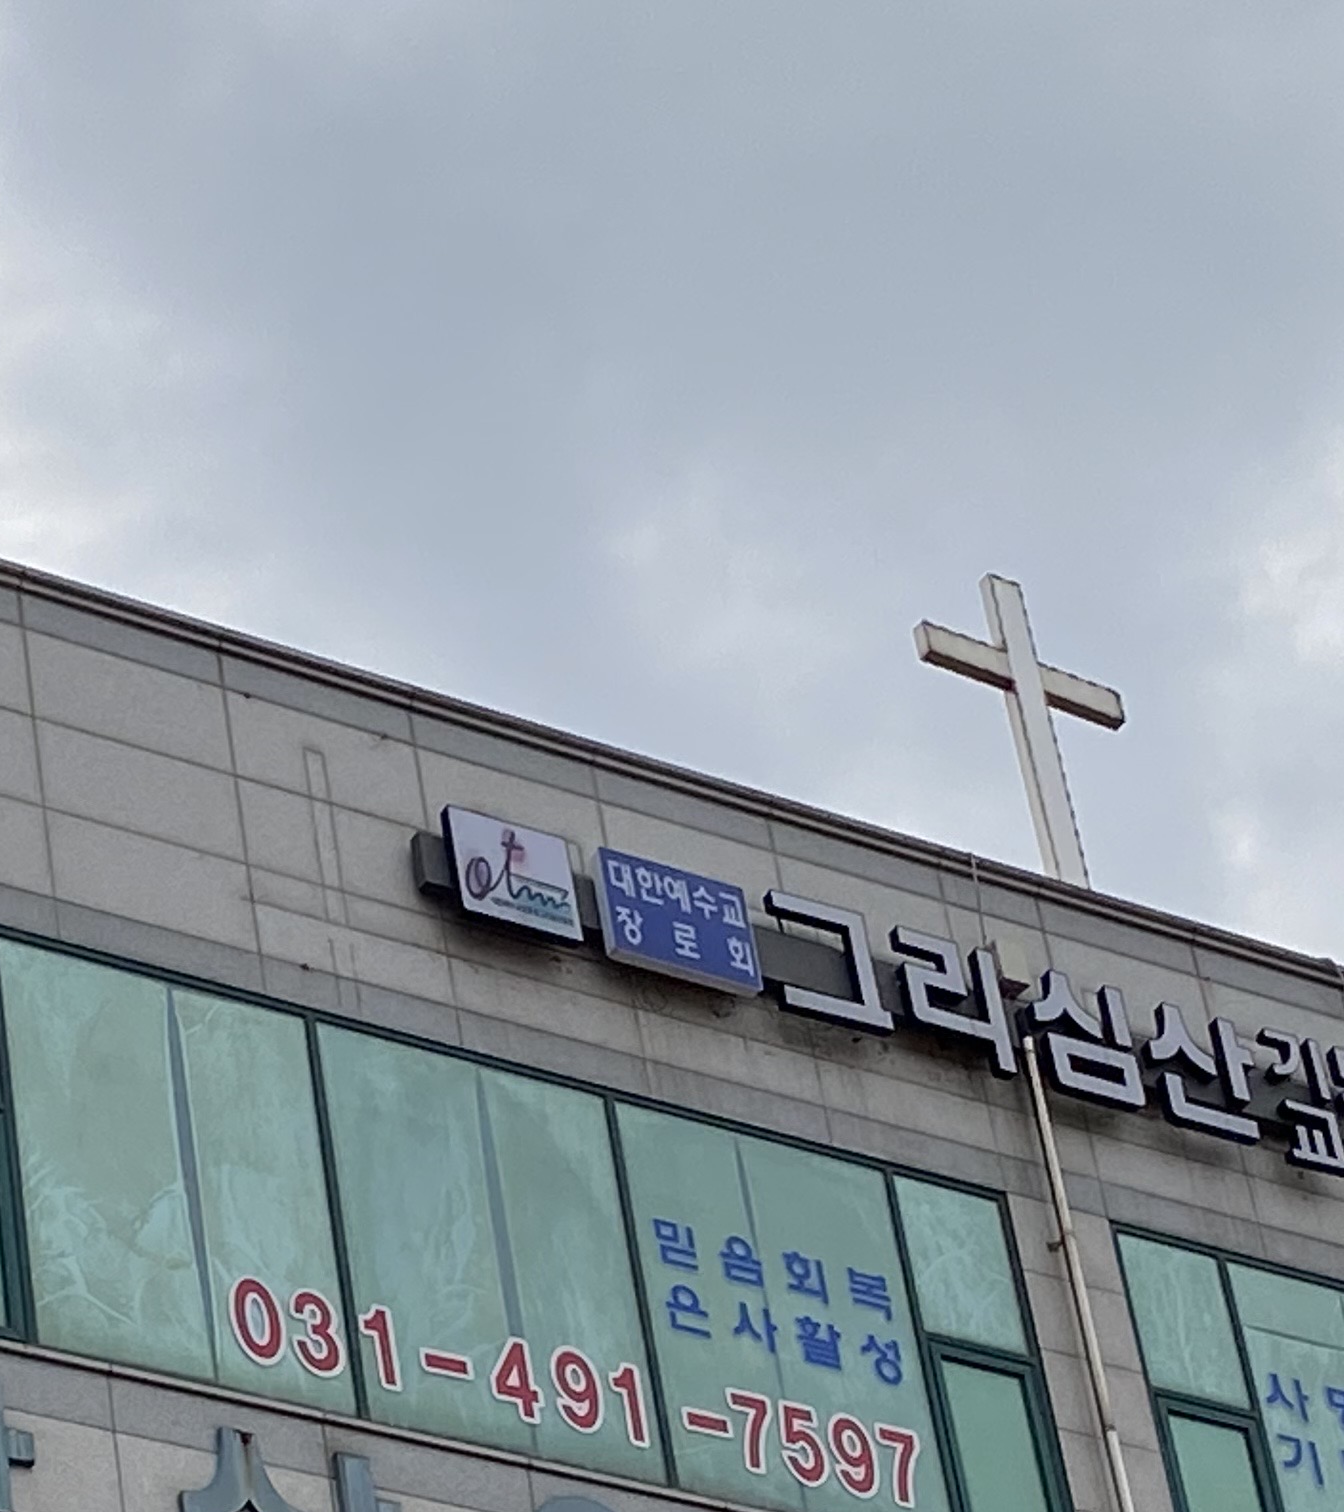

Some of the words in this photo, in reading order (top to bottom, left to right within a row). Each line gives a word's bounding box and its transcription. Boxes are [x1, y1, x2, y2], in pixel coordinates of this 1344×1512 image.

[607, 860, 746, 929] 대한예수교
[764, 889, 1260, 1143] 그리심산
[652, 1218, 892, 1322] 믿음회복
[665, 1284, 903, 1386] 은사활성
[229, 1277, 920, 1509] 031-491-7597
